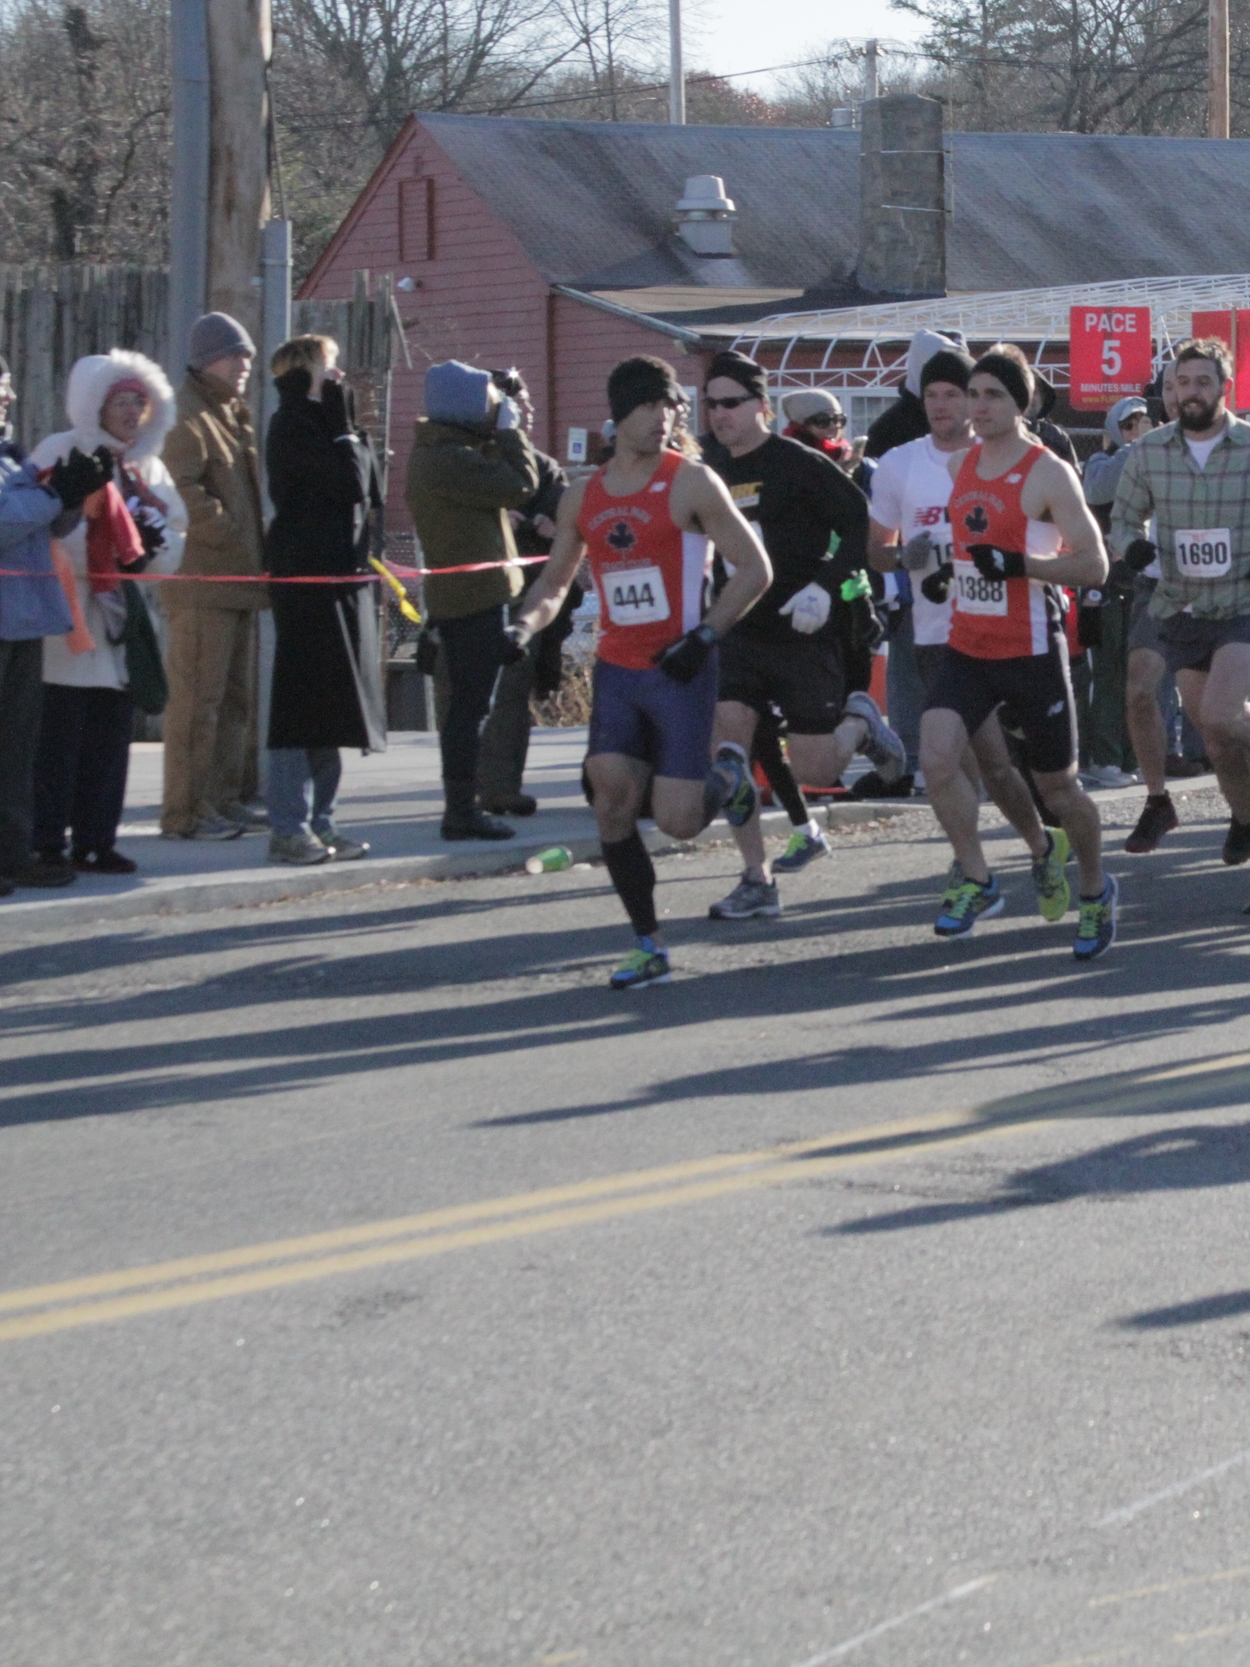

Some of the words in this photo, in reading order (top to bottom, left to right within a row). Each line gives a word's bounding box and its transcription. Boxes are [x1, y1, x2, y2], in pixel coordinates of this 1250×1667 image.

[1085, 313, 1137, 333] PACE
[1101, 340, 1122, 376] 5
[1179, 542, 1228, 565] 1690
[614, 582, 655, 609] 444
[958, 575, 1004, 602] 1388
